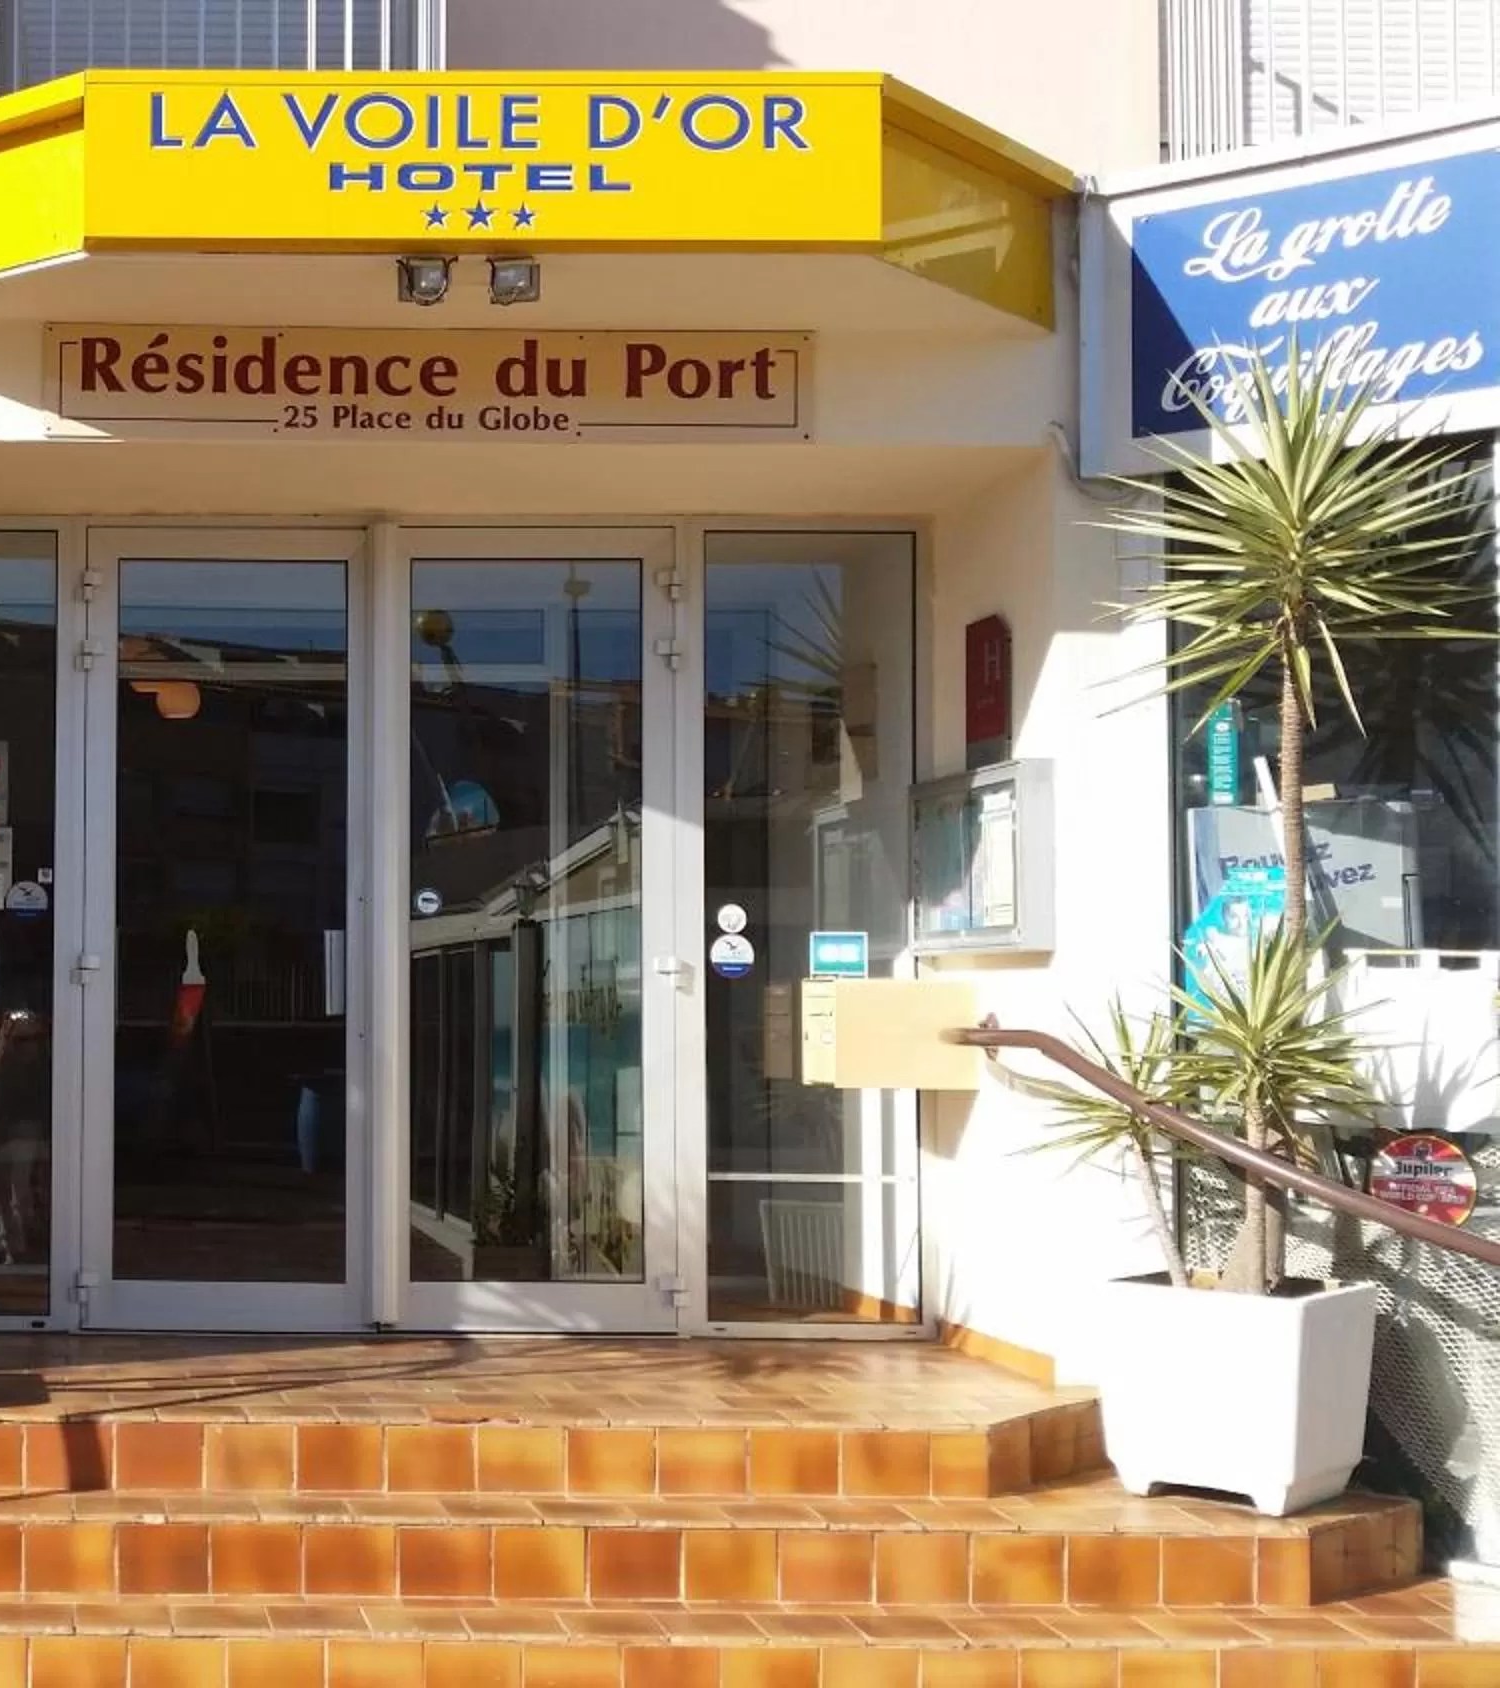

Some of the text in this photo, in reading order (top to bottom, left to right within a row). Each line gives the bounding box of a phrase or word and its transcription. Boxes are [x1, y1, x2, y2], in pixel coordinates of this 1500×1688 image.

[149, 88, 812, 153] LA VOILE D'OR
[328, 162, 634, 193] HOTEL
[1184, 175, 1453, 282] La grotte
[1247, 275, 1381, 328] aux
[80, 333, 776, 400] Résidence du Port
[283, 404, 570, 431] 25 Place du Globe
[1395, 1161, 1455, 1177] Jupiler
